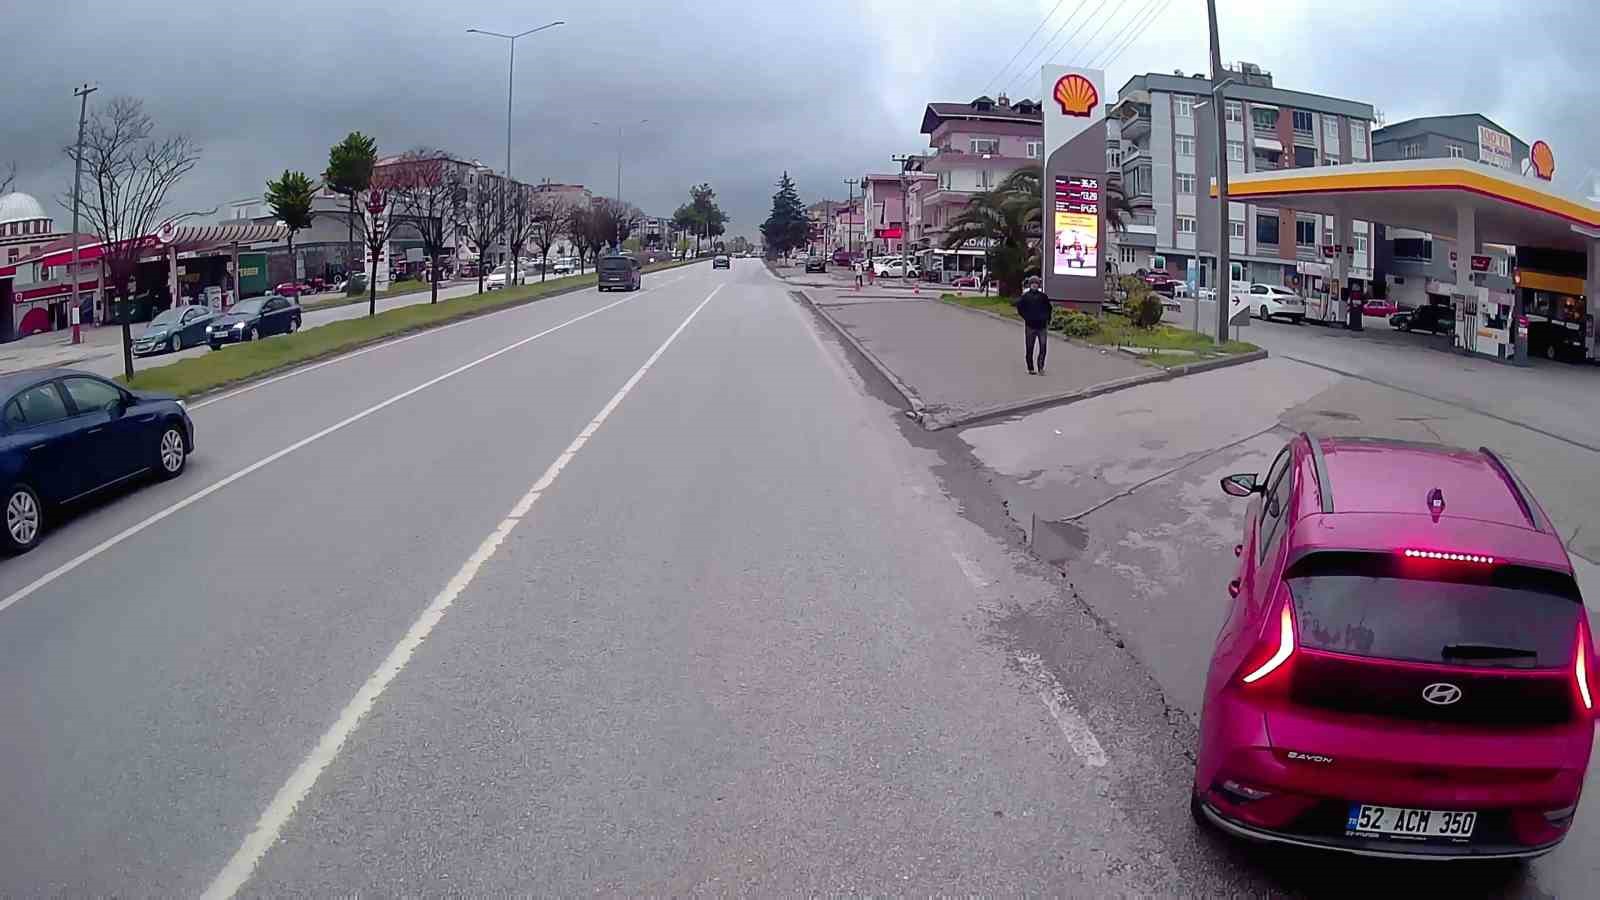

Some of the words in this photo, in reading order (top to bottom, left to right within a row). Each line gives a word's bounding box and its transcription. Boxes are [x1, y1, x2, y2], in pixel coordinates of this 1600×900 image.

[1287, 751, 1333, 764] BAYON
[1359, 806, 1384, 830] 52
[1394, 809, 1431, 833] ACM
[1439, 812, 1475, 834] 350
